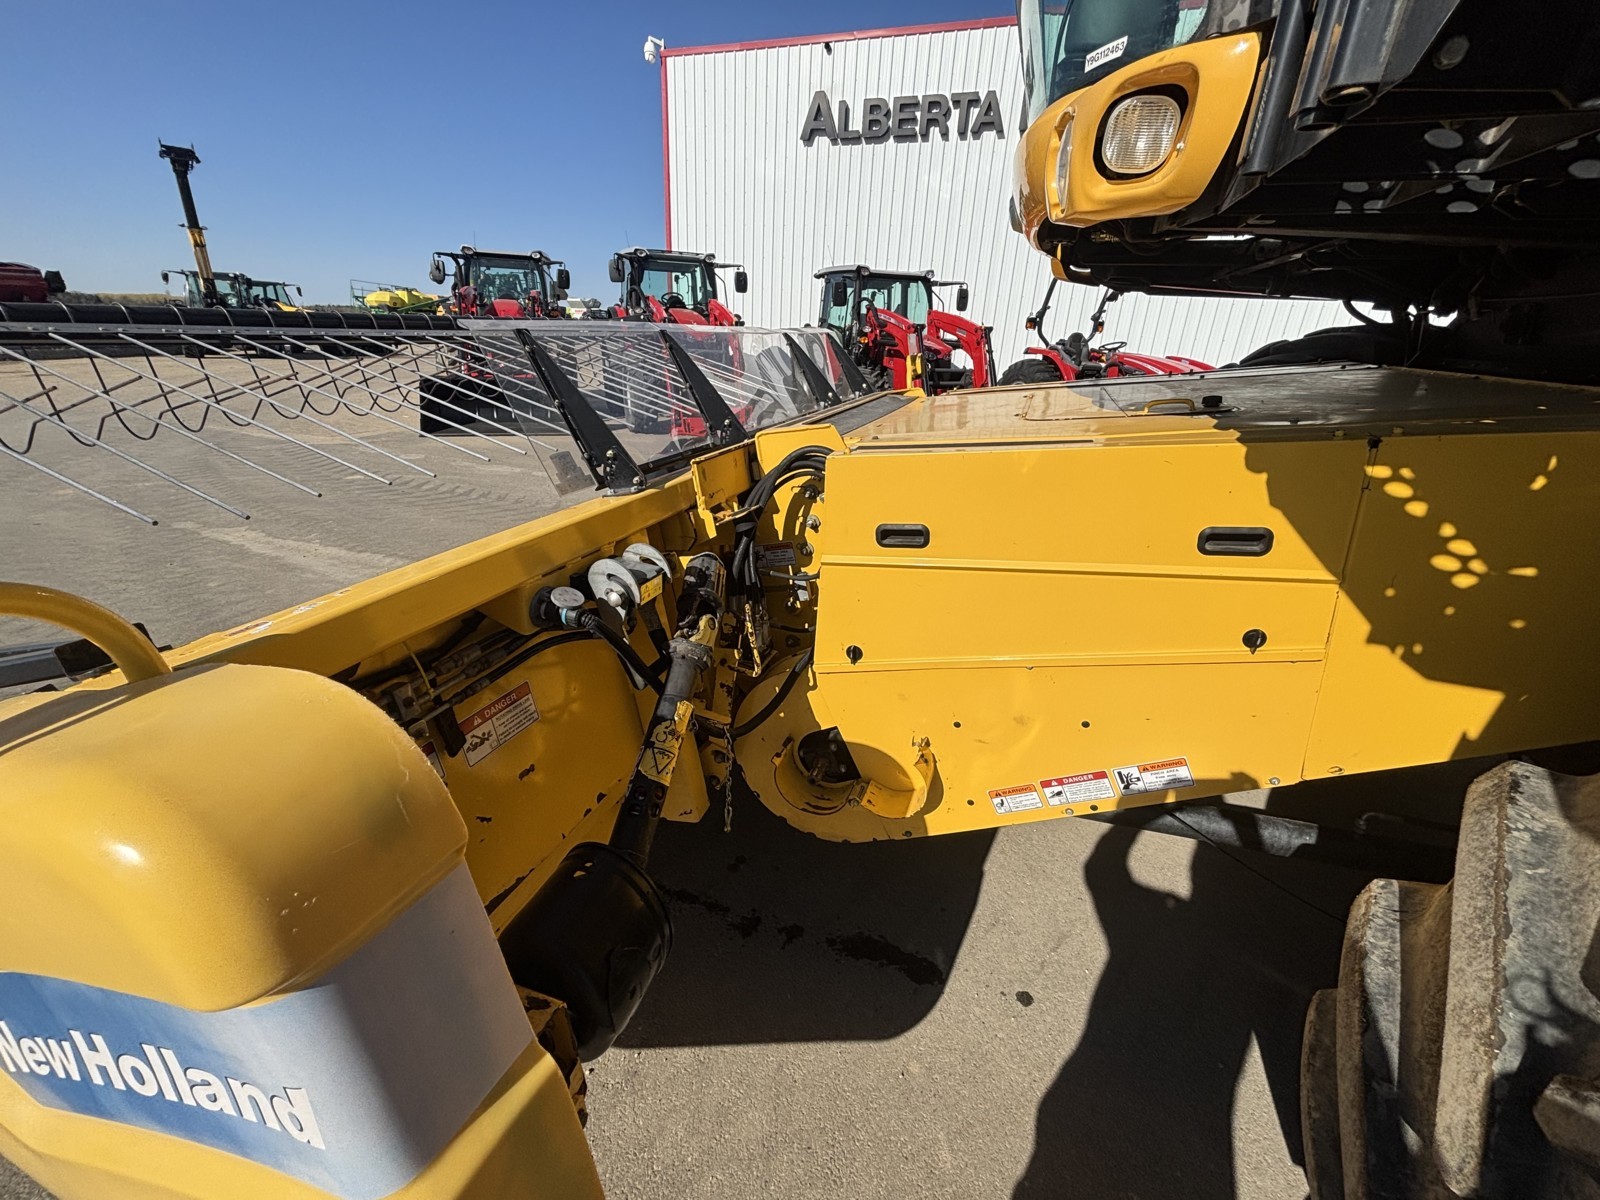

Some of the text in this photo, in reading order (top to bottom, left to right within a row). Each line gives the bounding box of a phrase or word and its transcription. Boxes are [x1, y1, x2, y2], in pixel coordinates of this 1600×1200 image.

[1086, 41, 1125, 67] Y9G112463
[800, 90, 1005, 144] ALBERTA
[484, 693, 517, 718] DANGER
[1149, 760, 1183, 770] WARNING
[1002, 786, 1033, 796] WARNING
[1062, 774, 1094, 784] DANGER
[0, 1020, 326, 1150] New Holland
